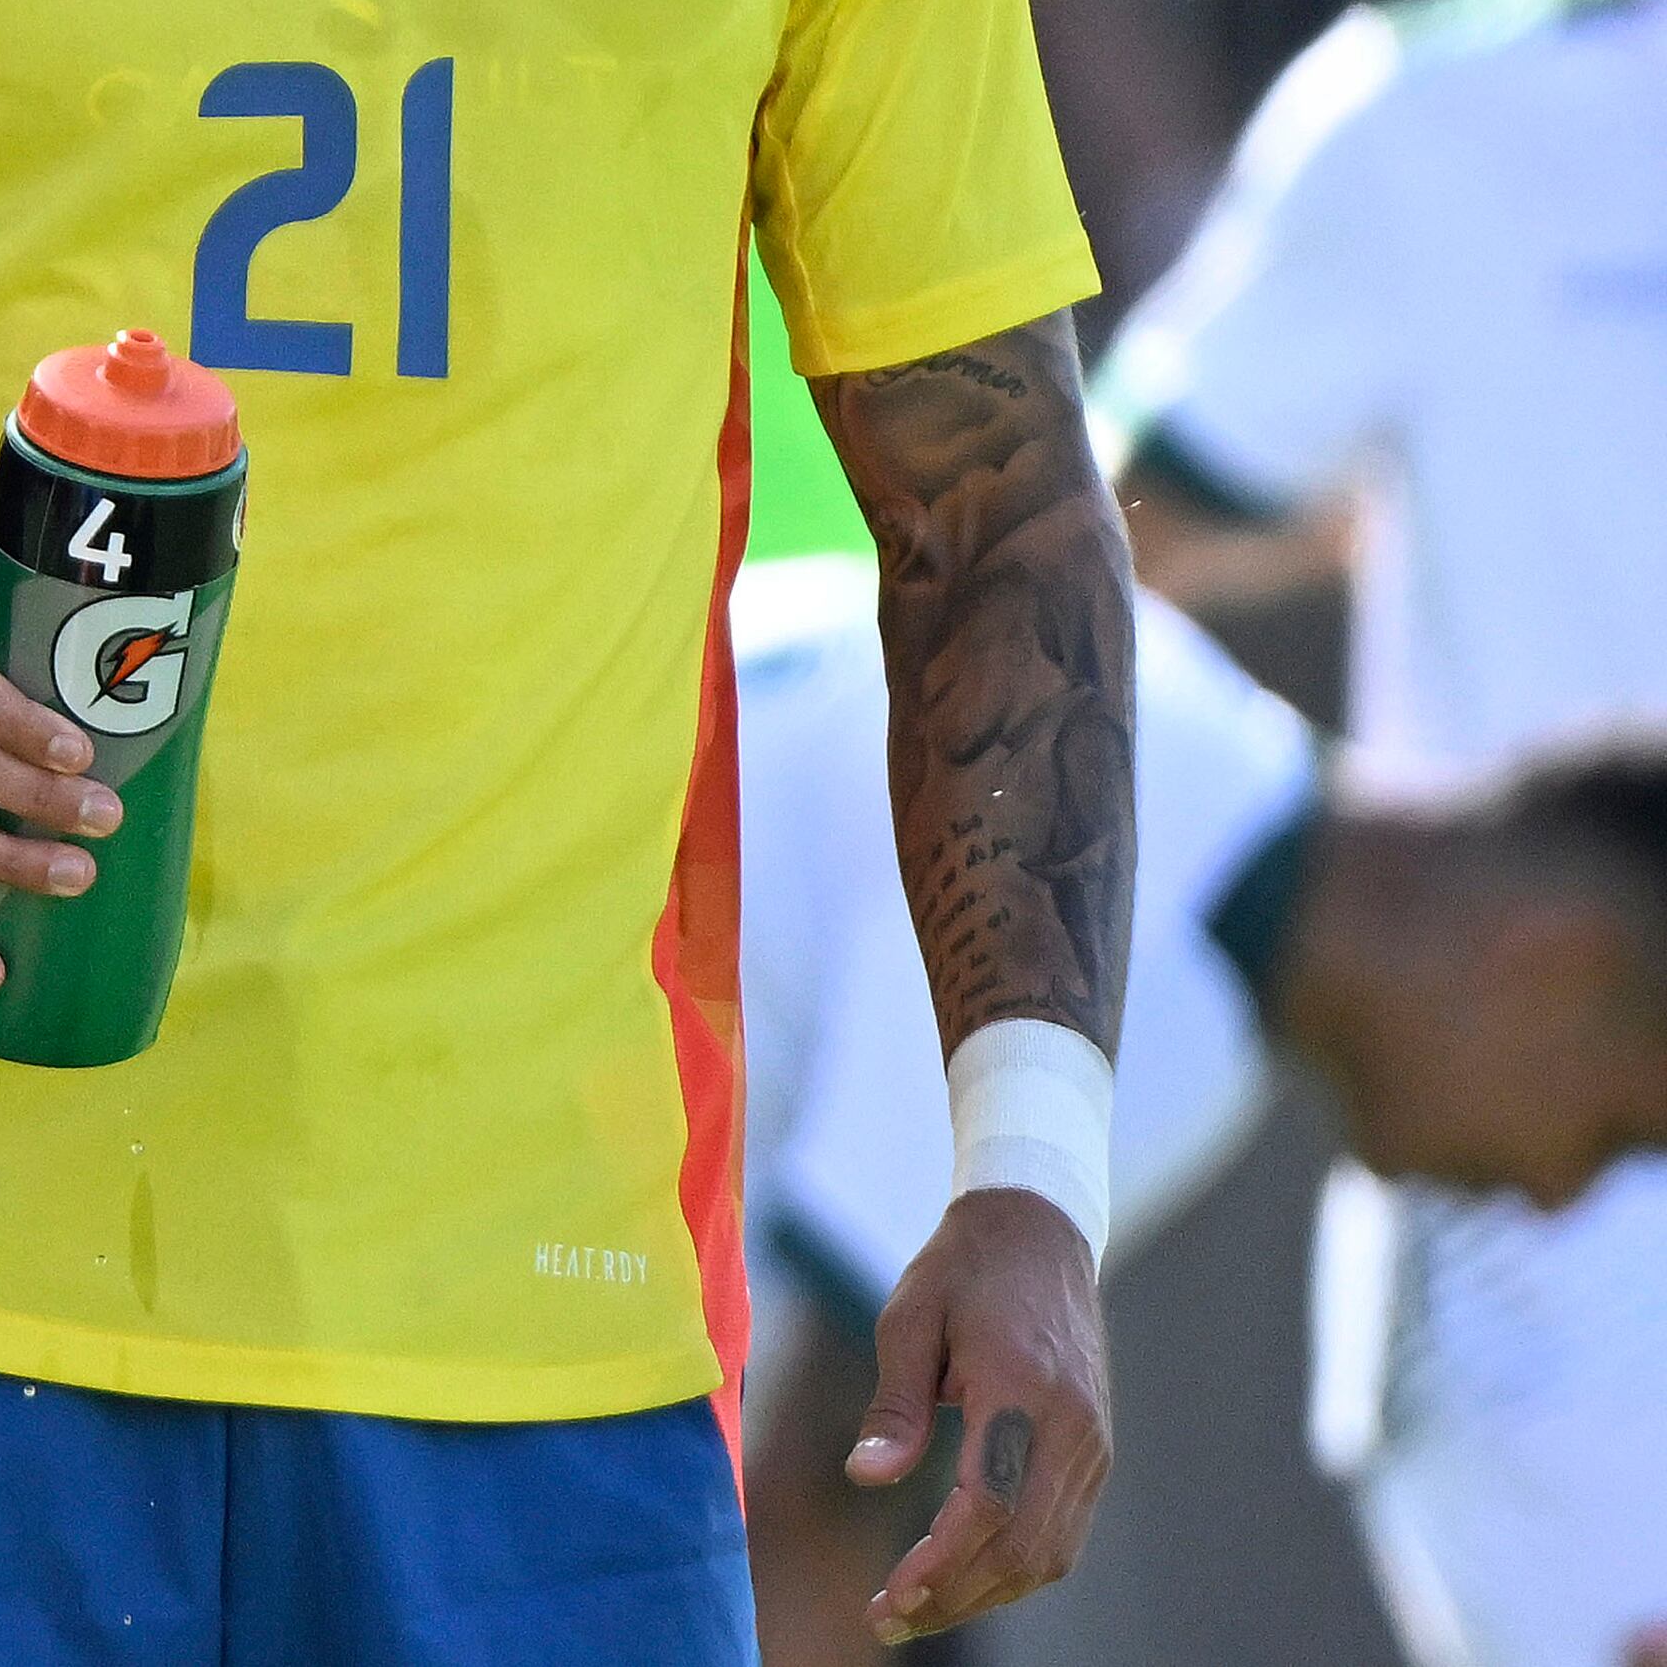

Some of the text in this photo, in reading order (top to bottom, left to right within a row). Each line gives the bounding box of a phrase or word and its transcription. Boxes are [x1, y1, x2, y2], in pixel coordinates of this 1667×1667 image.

[188, 56, 454, 379] 21
[68, 498, 133, 583] 4
[51, 588, 195, 737] G
